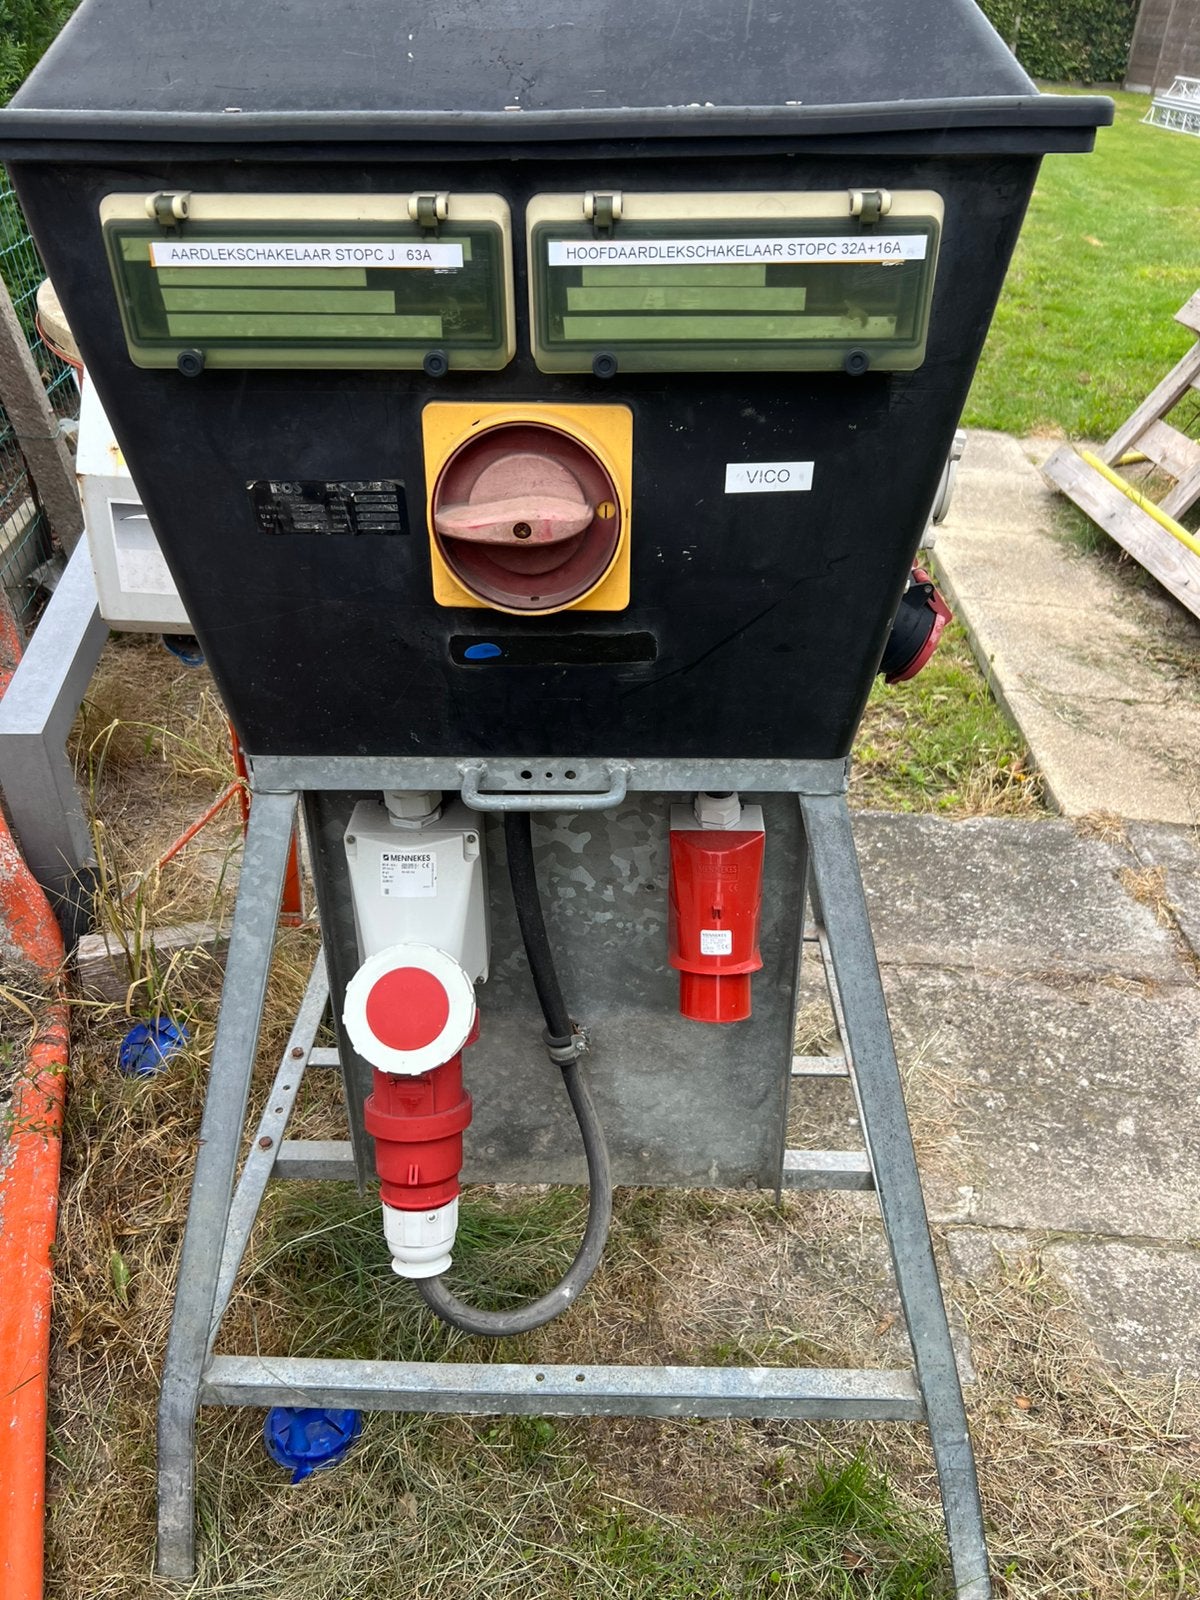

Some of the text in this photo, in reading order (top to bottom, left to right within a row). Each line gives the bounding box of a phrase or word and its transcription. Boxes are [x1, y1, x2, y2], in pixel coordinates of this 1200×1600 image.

[170, 248, 432, 261] AARDLEKSCHAKELAAR STOPC J 63A
[566, 241, 902, 260] HOOFDAARDLEKSCHAKELAAR STOPC 32A+16A
[746, 469, 791, 484] VICO
[390, 854, 431, 862] MENNEKES
